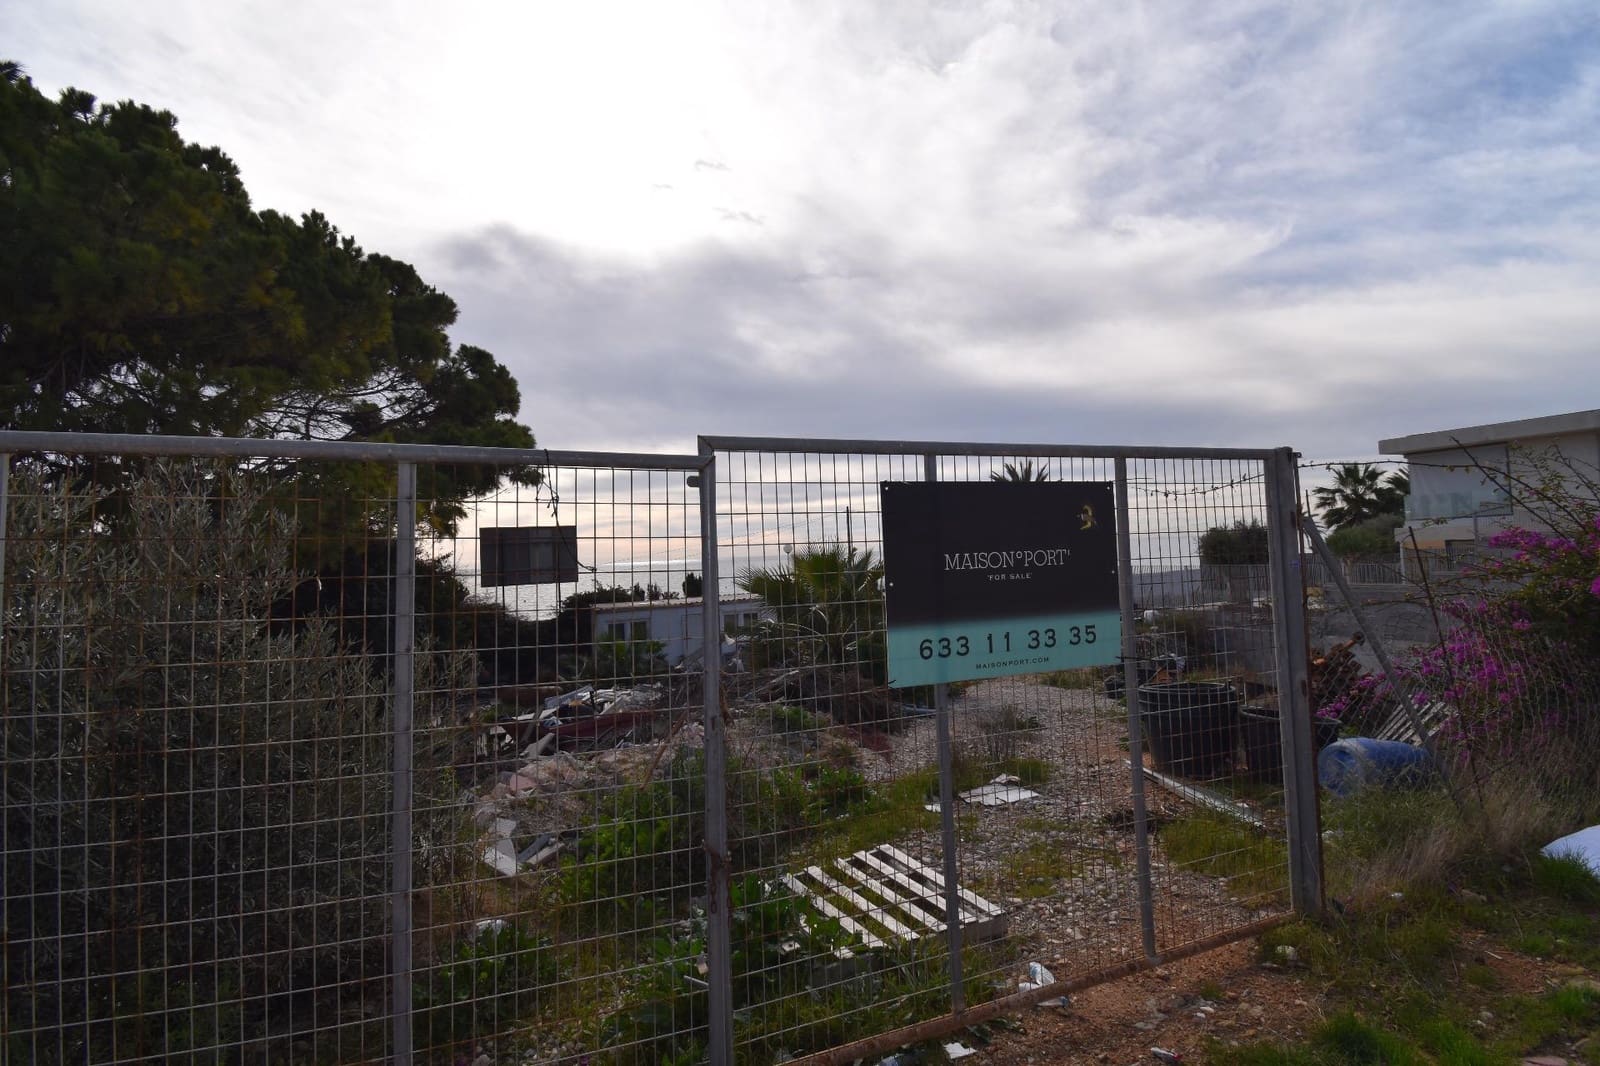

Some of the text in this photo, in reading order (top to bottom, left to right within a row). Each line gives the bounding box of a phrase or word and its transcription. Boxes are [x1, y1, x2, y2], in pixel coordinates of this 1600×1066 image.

[919, 624, 1097, 660] 633 11 33 35
[975, 656, 1050, 669] MAISONPORT.COM
